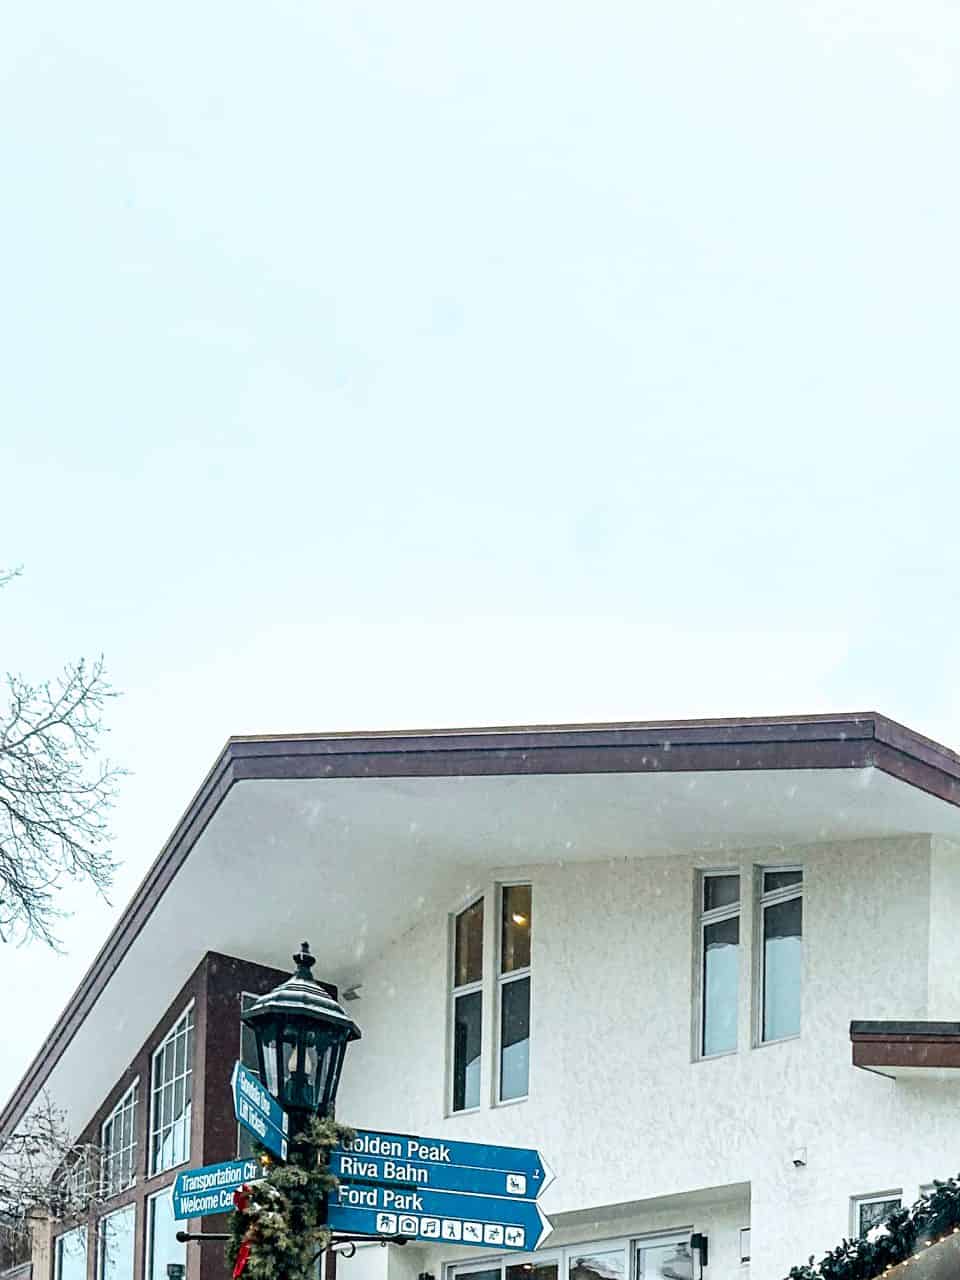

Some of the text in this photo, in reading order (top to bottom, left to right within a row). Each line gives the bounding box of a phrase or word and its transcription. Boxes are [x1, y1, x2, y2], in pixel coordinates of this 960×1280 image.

[407, 1140, 451, 1162] Peak
[182, 1162, 258, 1192] Transportation Ctr
[340, 1157, 428, 1183] Riva Bahn
[181, 1194, 218, 1215] Welcome
[338, 1185, 423, 1211] Ford Park
